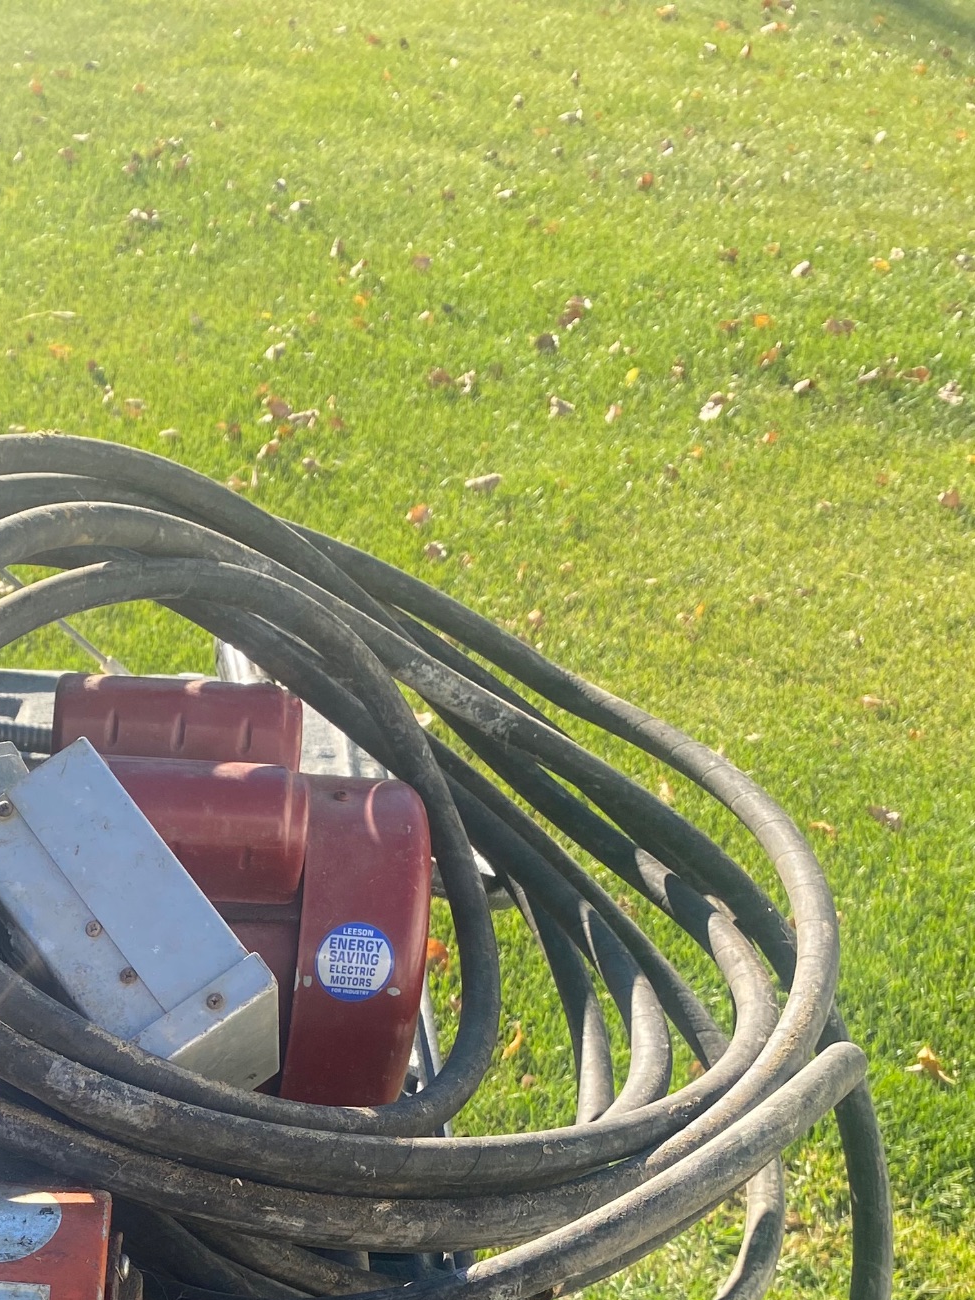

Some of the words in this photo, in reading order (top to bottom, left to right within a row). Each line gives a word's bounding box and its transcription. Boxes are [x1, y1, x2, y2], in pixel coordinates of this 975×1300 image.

[343, 927, 374, 937] LEESON
[329, 937, 384, 953] ENERGY
[329, 950, 380, 966] SAVING
[329, 964, 376, 976] ELECTRIC
[330, 976, 372, 988] MOTORS
